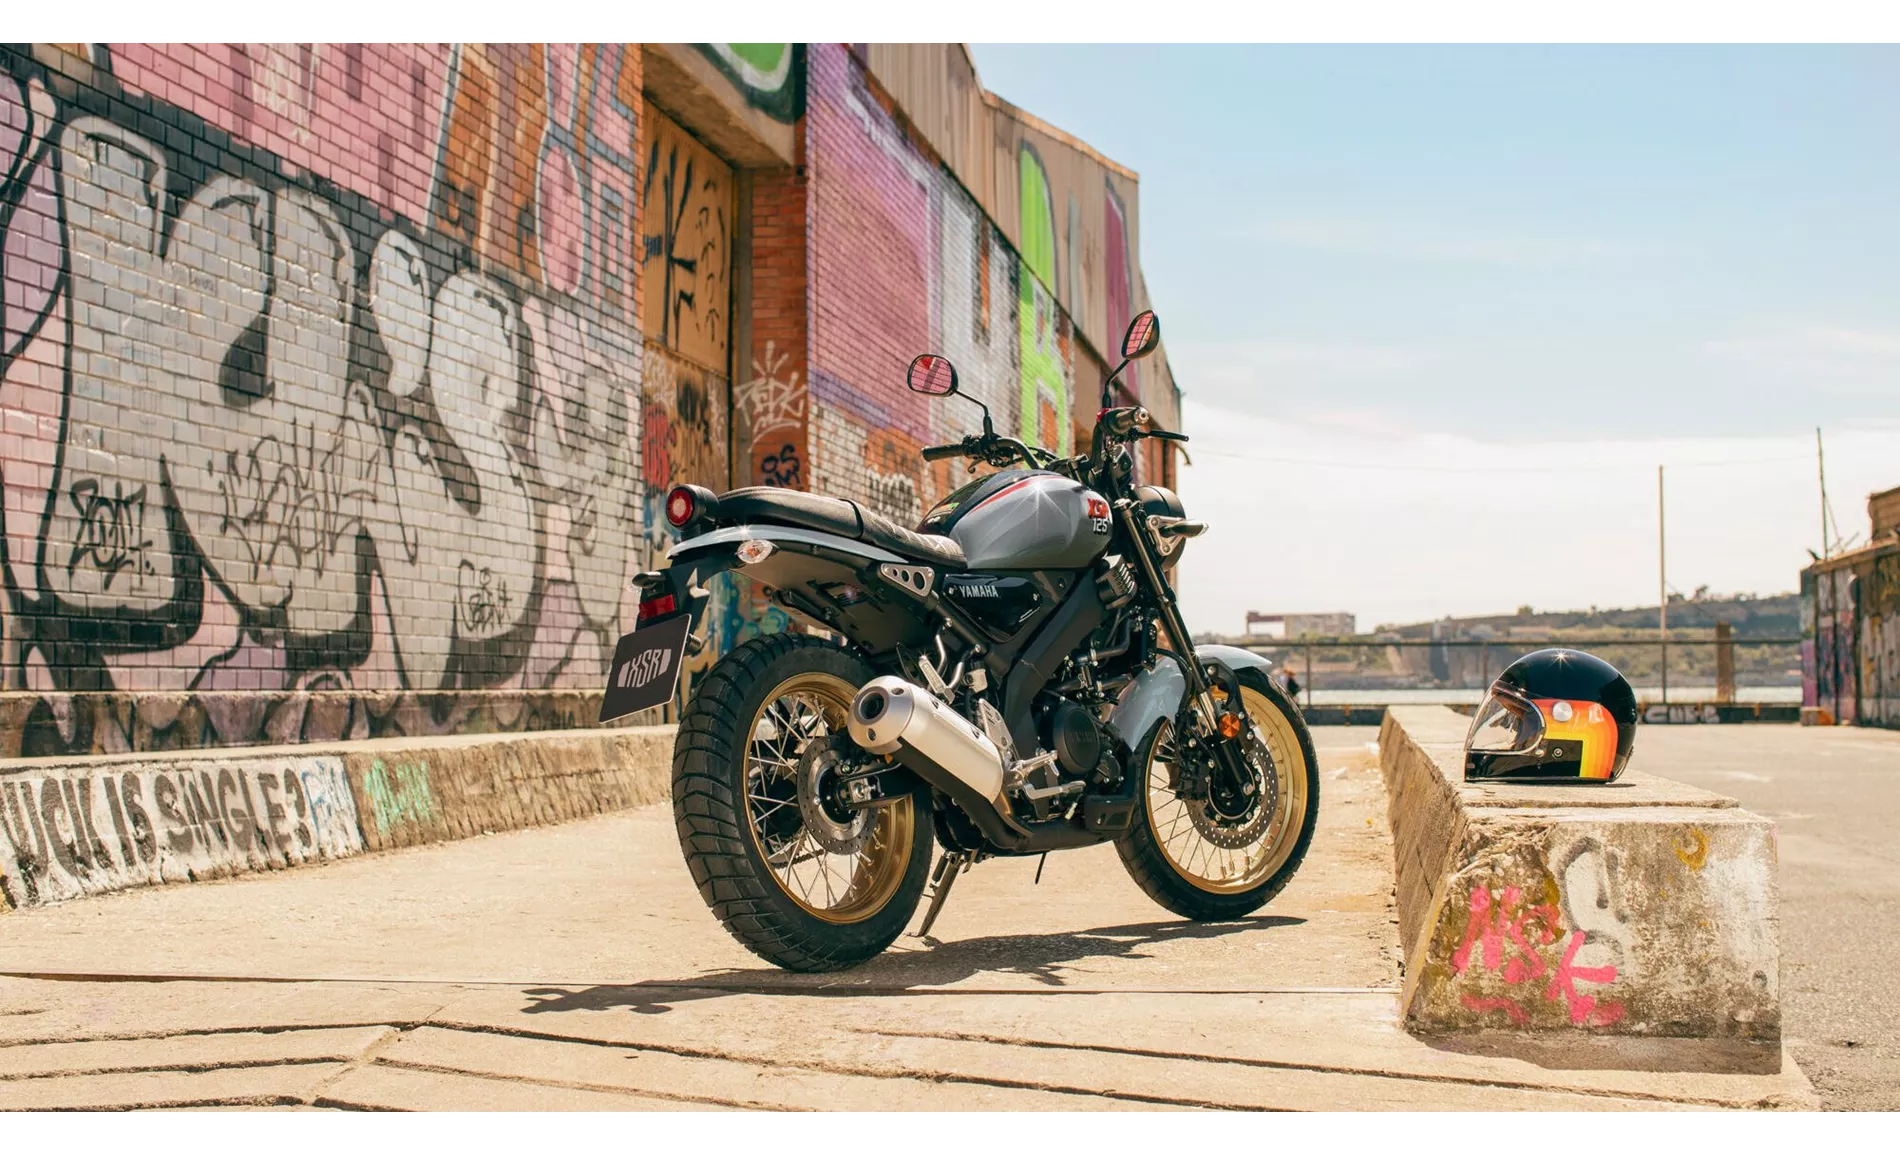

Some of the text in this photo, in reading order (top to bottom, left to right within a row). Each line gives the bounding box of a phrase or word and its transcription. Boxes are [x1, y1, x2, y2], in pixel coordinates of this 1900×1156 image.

[1086, 498, 1109, 518] XSR
[1092, 518, 1108, 533] 125
[958, 585, 999, 598] YAMAHA
[624, 648, 664, 688] XSR
[102, 771, 157, 866] IS
